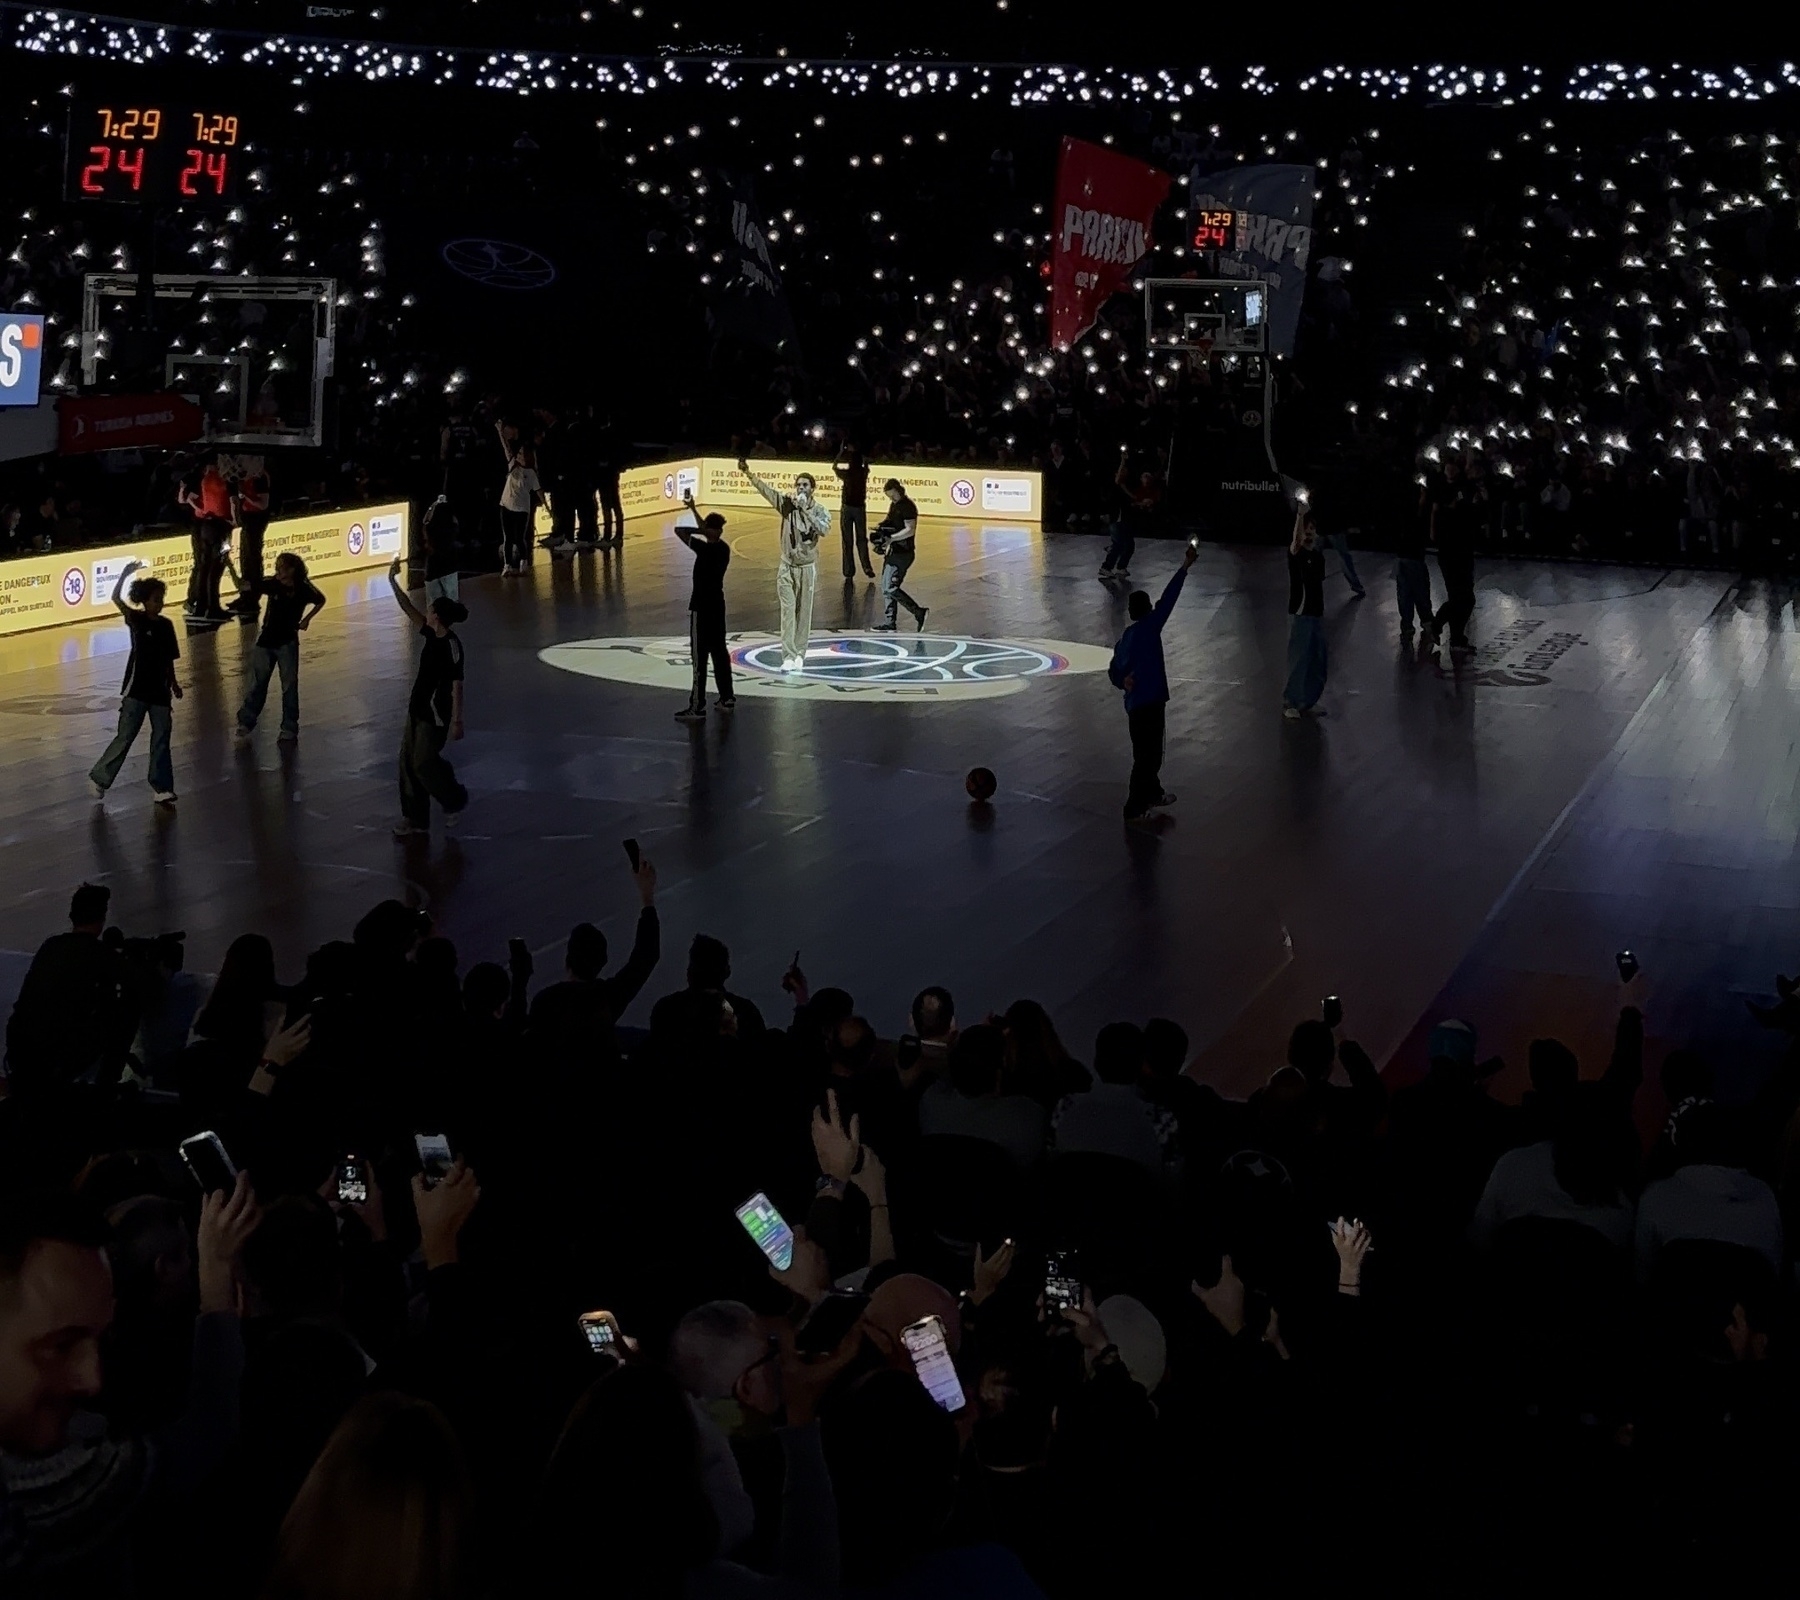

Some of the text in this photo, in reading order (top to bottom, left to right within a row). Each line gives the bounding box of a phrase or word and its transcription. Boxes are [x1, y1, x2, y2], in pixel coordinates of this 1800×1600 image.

[97, 109, 238, 146] 7:29 7:29
[82, 146, 227, 194] 24 24
[1200, 211, 1232, 227] 7:29
[1194, 227, 1226, 247] 24
[153, 555, 165, 567] LES
[66, 578, 81, 594] -18
